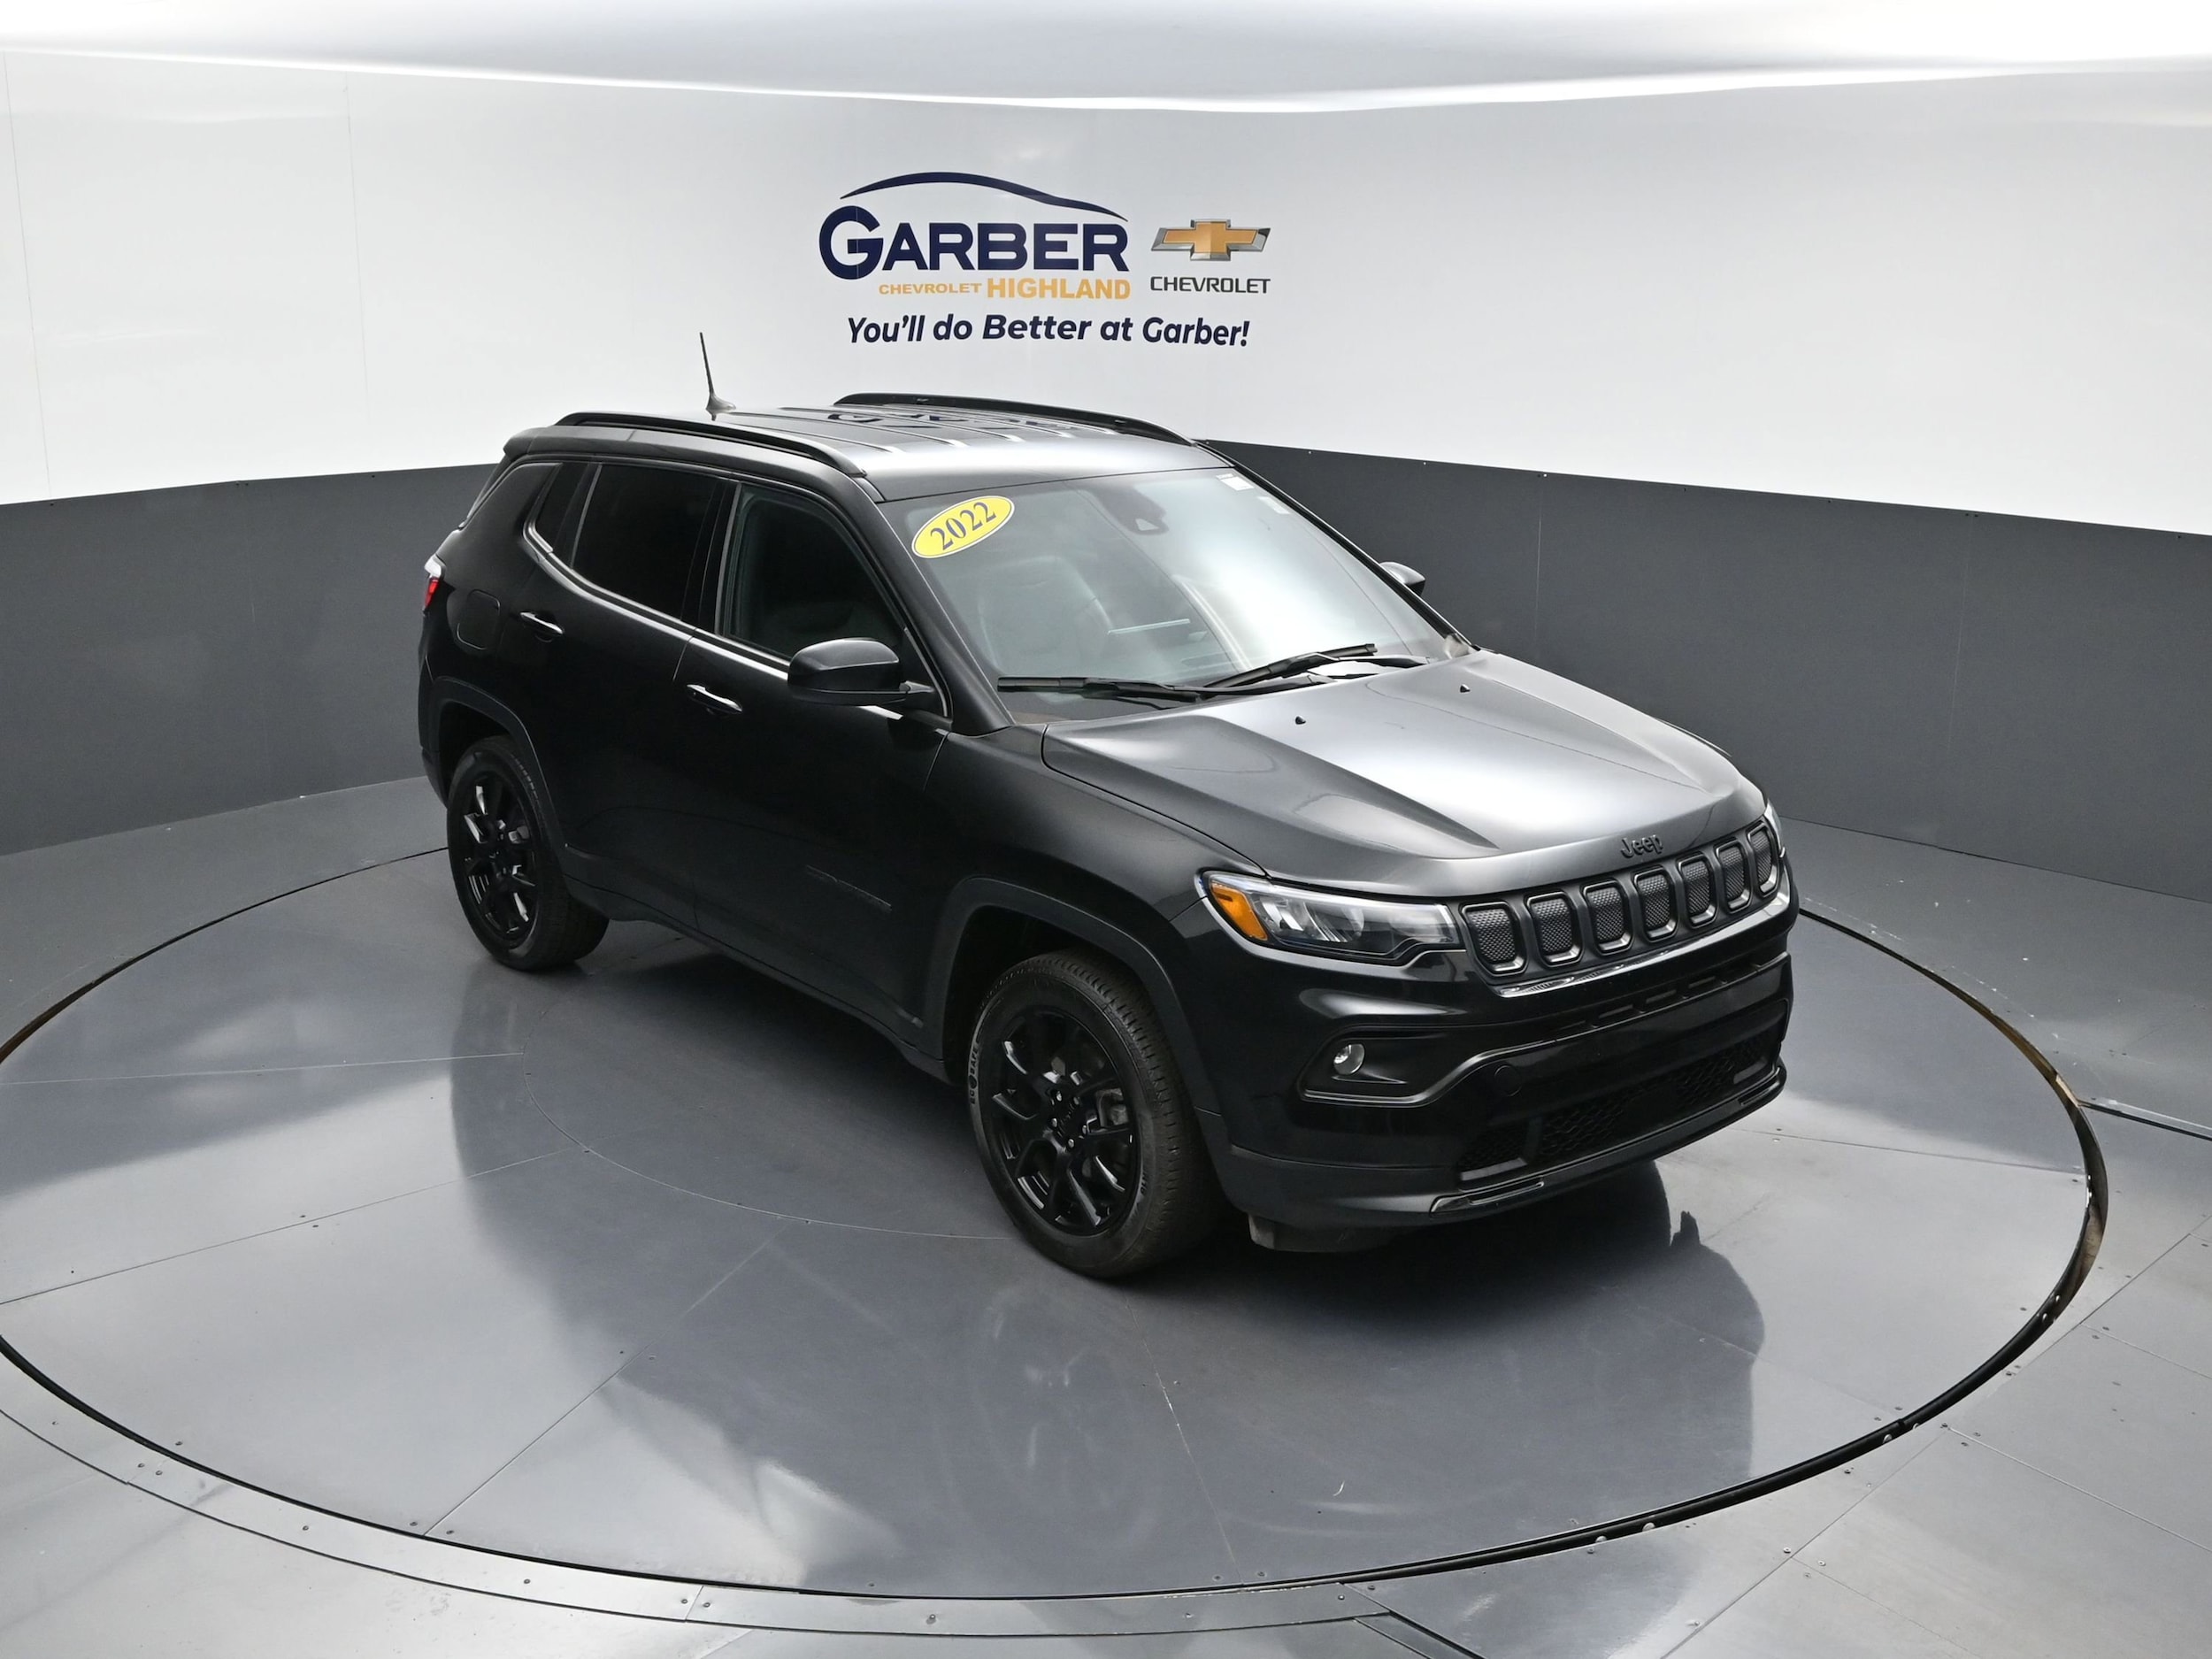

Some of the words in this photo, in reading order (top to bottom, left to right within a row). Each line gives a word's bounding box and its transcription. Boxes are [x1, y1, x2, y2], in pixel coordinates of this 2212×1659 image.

[818, 204, 1130, 280] GARBER
[879, 282, 982, 295] CHEVROLET
[987, 278, 1131, 300] HIGHLAND
[1150, 276, 1271, 294] CHEVROLET
[848, 314, 926, 343] You'll
[933, 313, 973, 341] do
[982, 314, 1093, 341] Better
[1100, 317, 1133, 342] at
[1142, 316, 1250, 347] Garber!
[930, 502, 997, 550] 2022
[1620, 834, 1663, 858] Jeep
